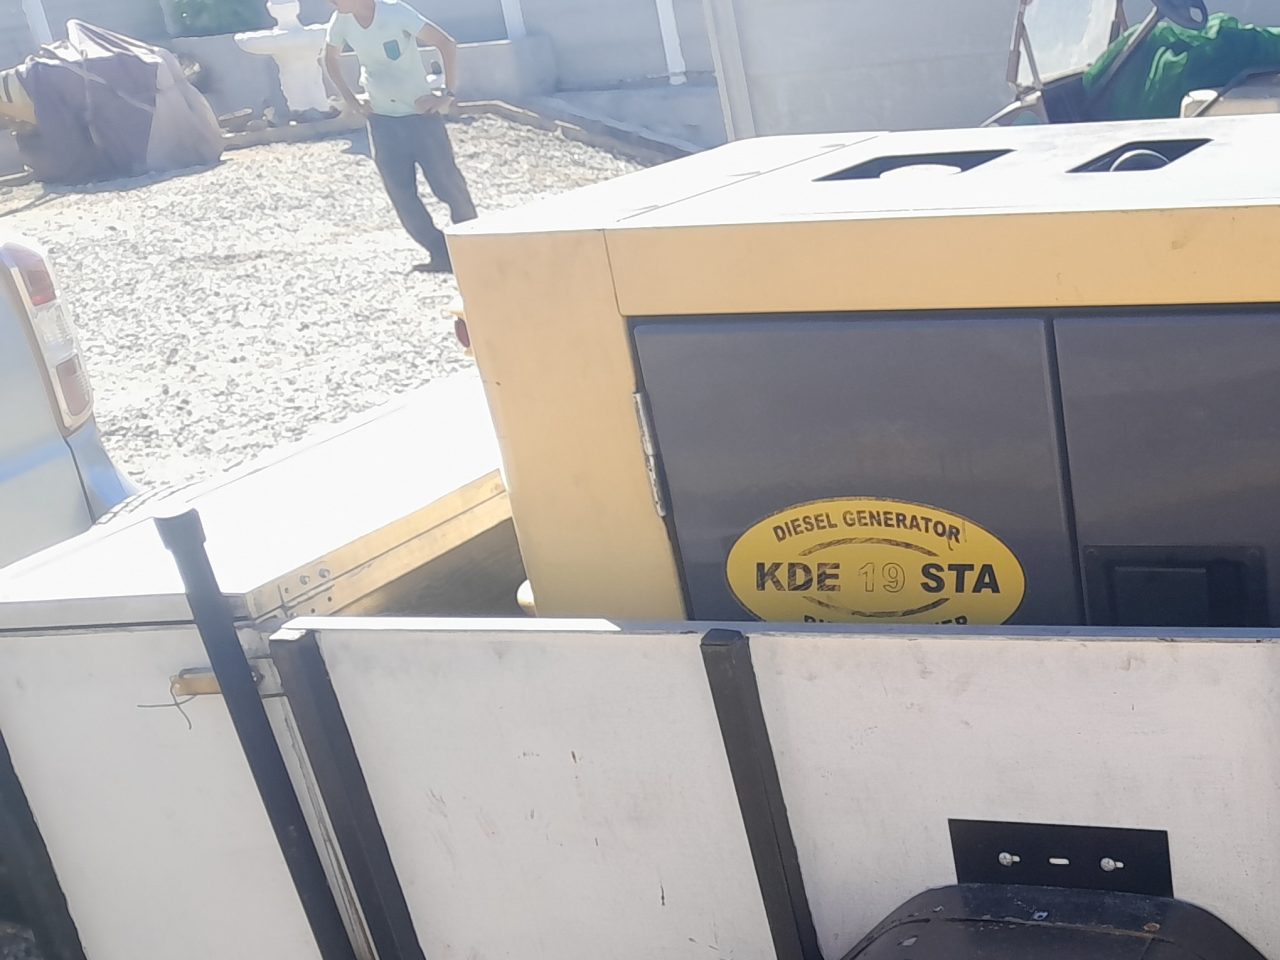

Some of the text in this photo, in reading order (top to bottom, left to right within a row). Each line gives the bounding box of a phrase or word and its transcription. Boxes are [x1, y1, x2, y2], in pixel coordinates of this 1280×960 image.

[773, 510, 961, 545] DIESEL GENERATOR
[756, 562, 1001, 594] KDE 19 STA
